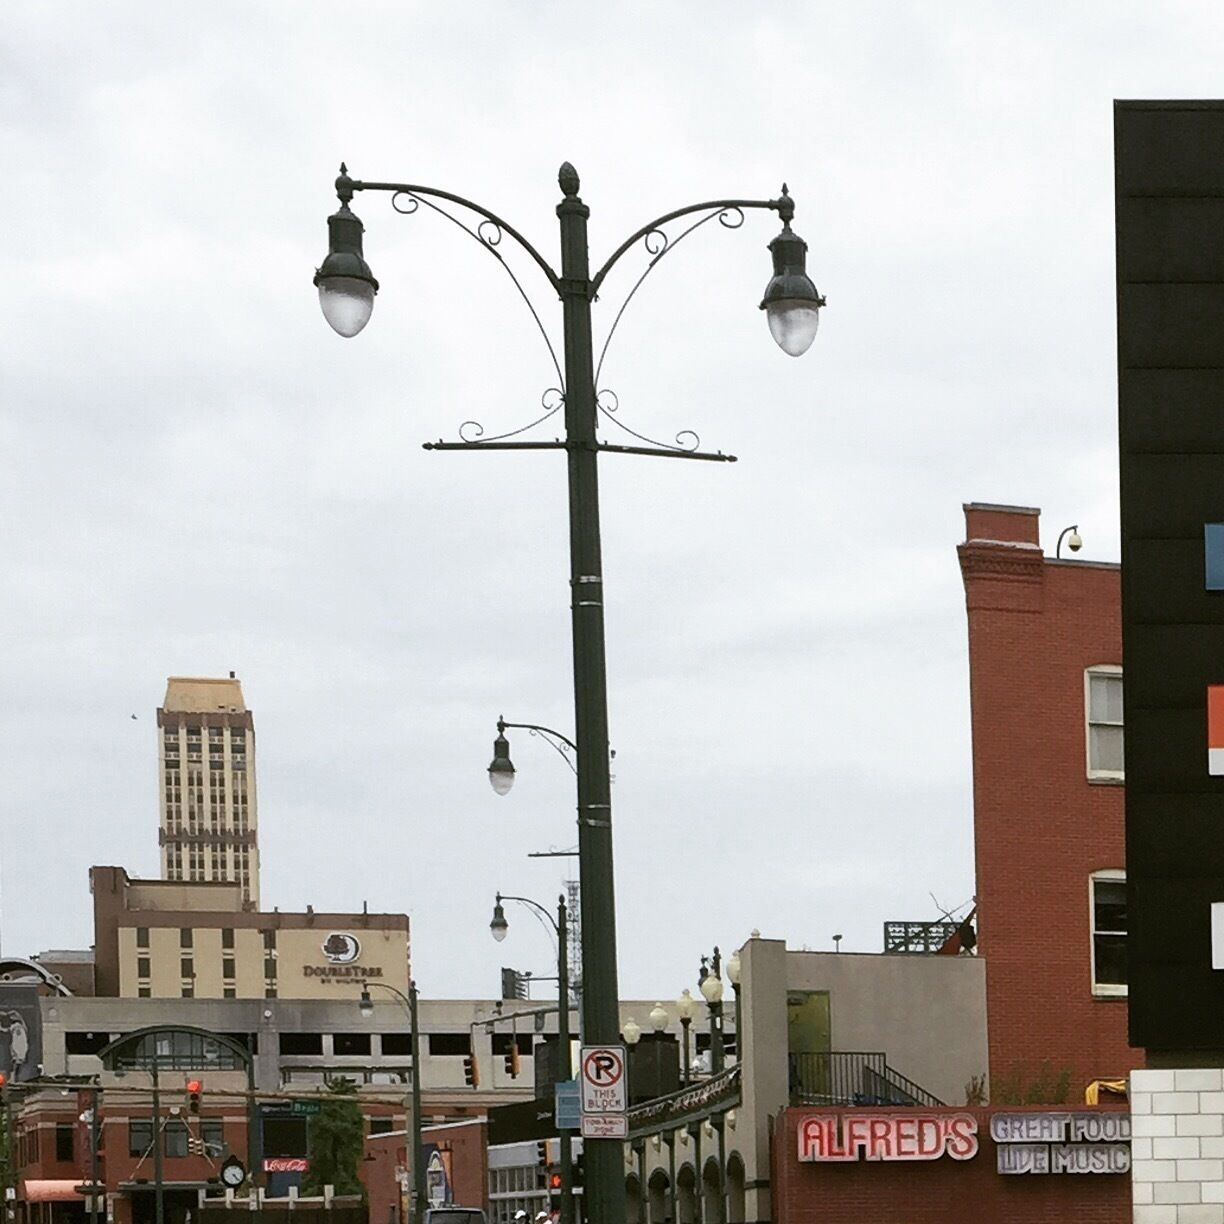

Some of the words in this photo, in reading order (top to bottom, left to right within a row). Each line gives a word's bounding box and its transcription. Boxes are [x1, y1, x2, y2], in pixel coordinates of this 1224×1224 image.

[587, 1099, 622, 1108] BLOCK
[593, 1090, 616, 1098] THIS
[802, 1117, 975, 1157] ALFRED'S
[993, 1116, 1067, 1140] GREAT
[1073, 1116, 1132, 1139] FOOD
[1000, 1147, 1047, 1172] LIVE
[1054, 1145, 1129, 1172] MUSIC
